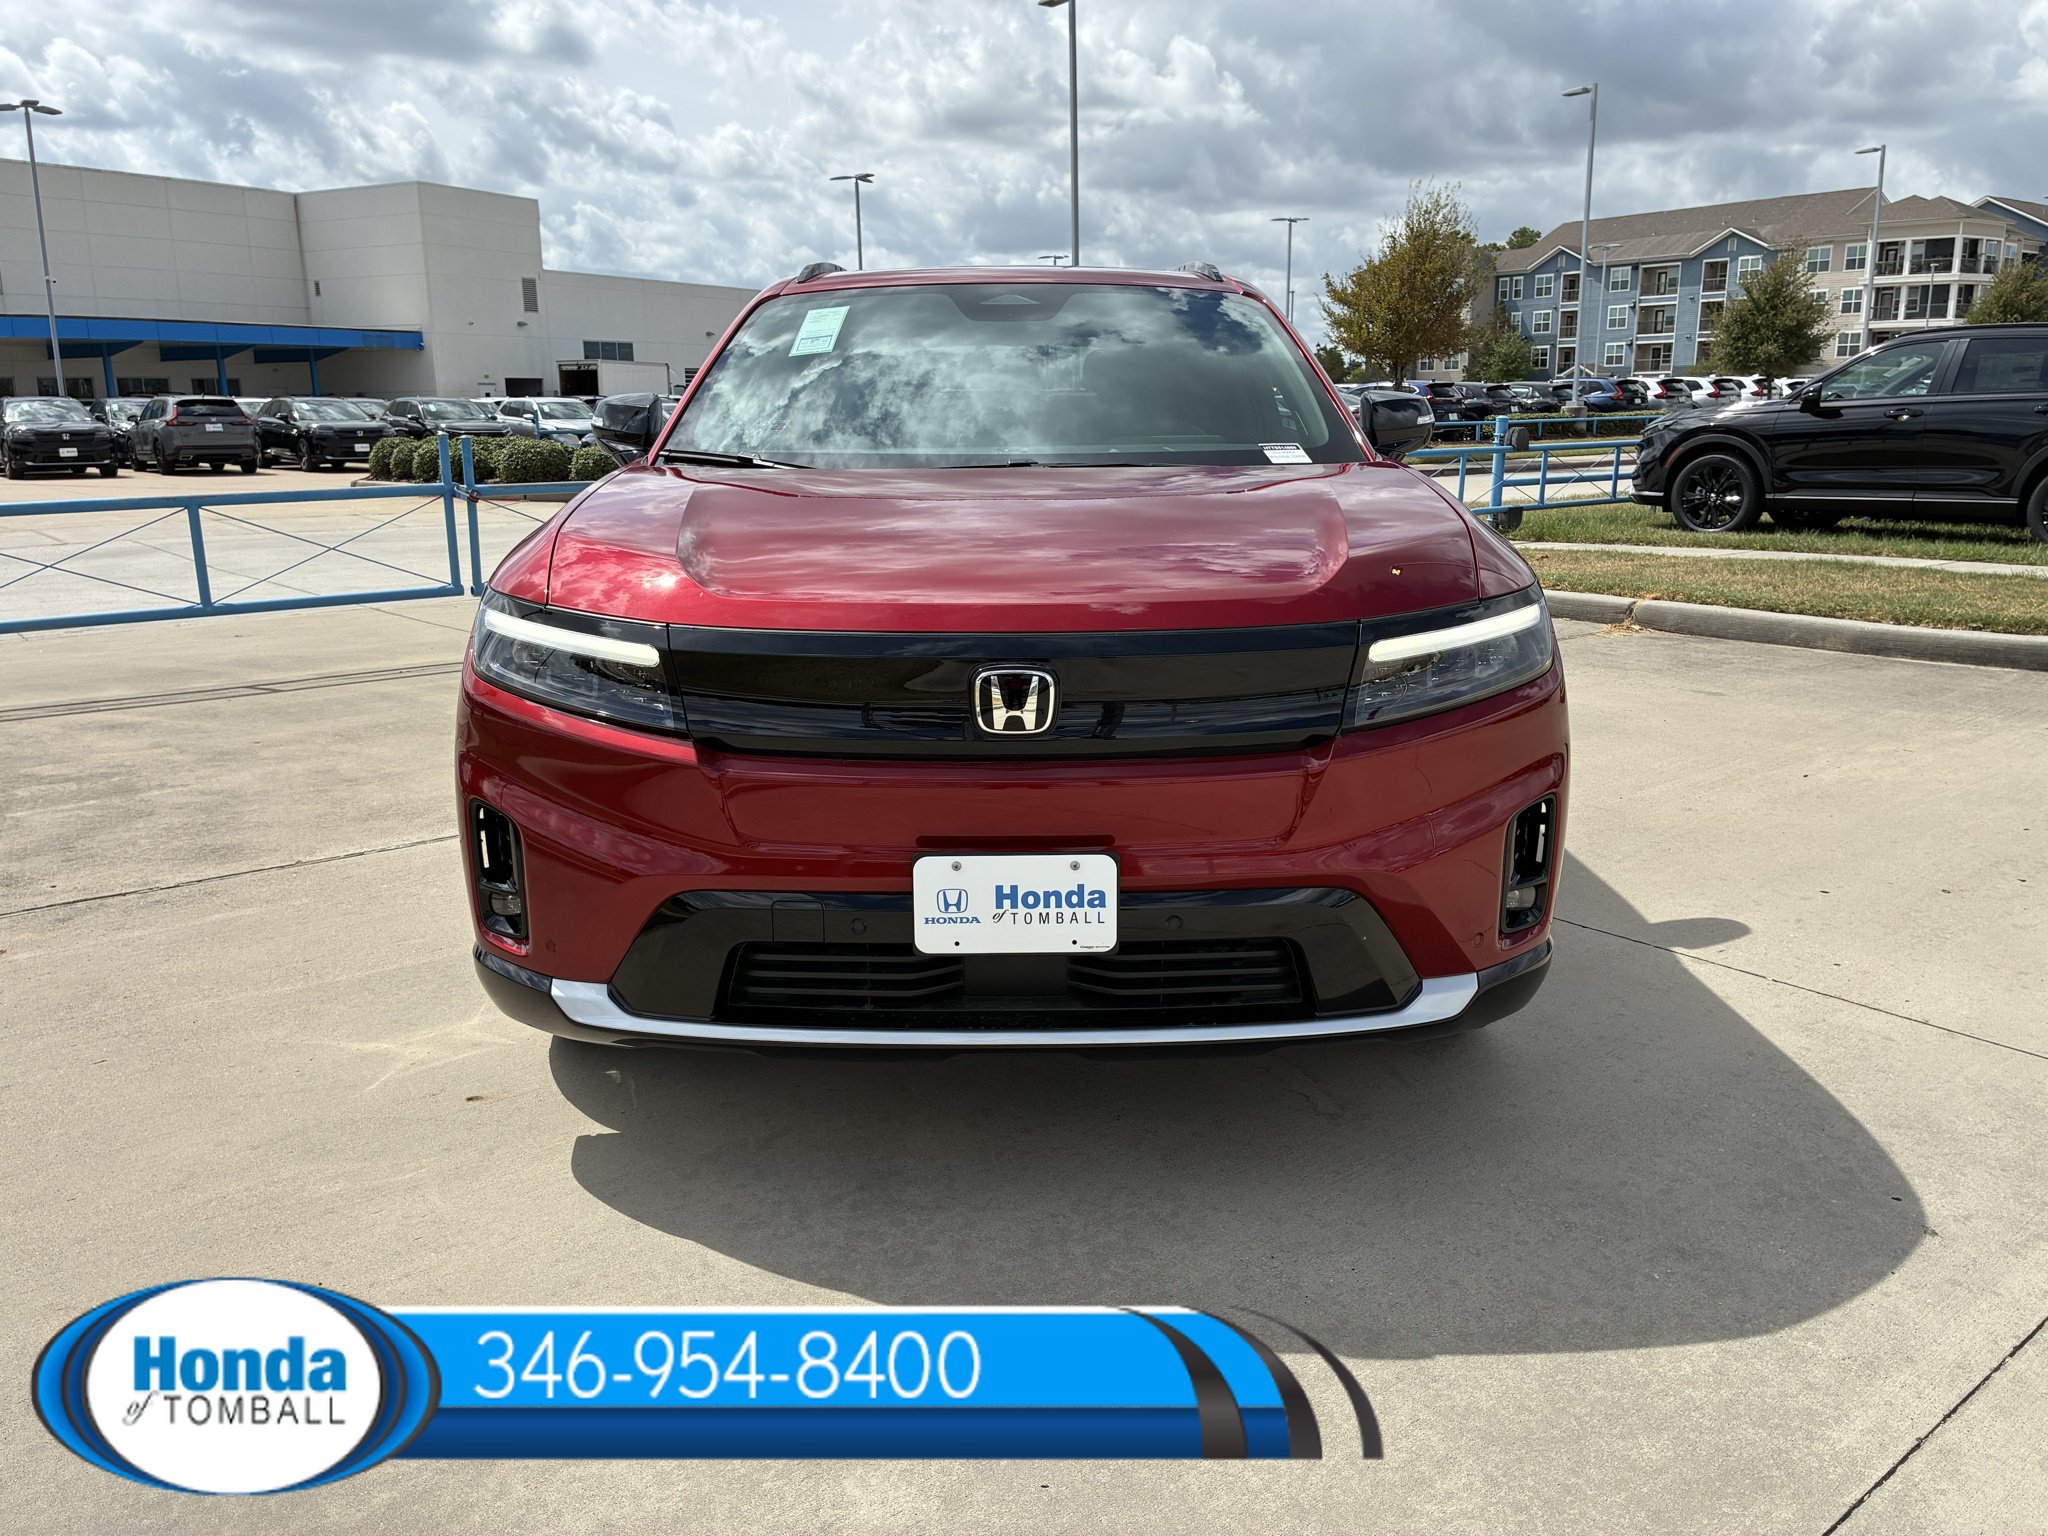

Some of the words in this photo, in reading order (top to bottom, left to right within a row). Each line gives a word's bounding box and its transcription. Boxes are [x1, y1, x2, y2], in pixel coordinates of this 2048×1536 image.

[994, 883, 1107, 910] Honda
[923, 916, 982, 925] HONDA
[992, 909, 1009, 924] of
[1010, 911, 1106, 925] TOMBALL
